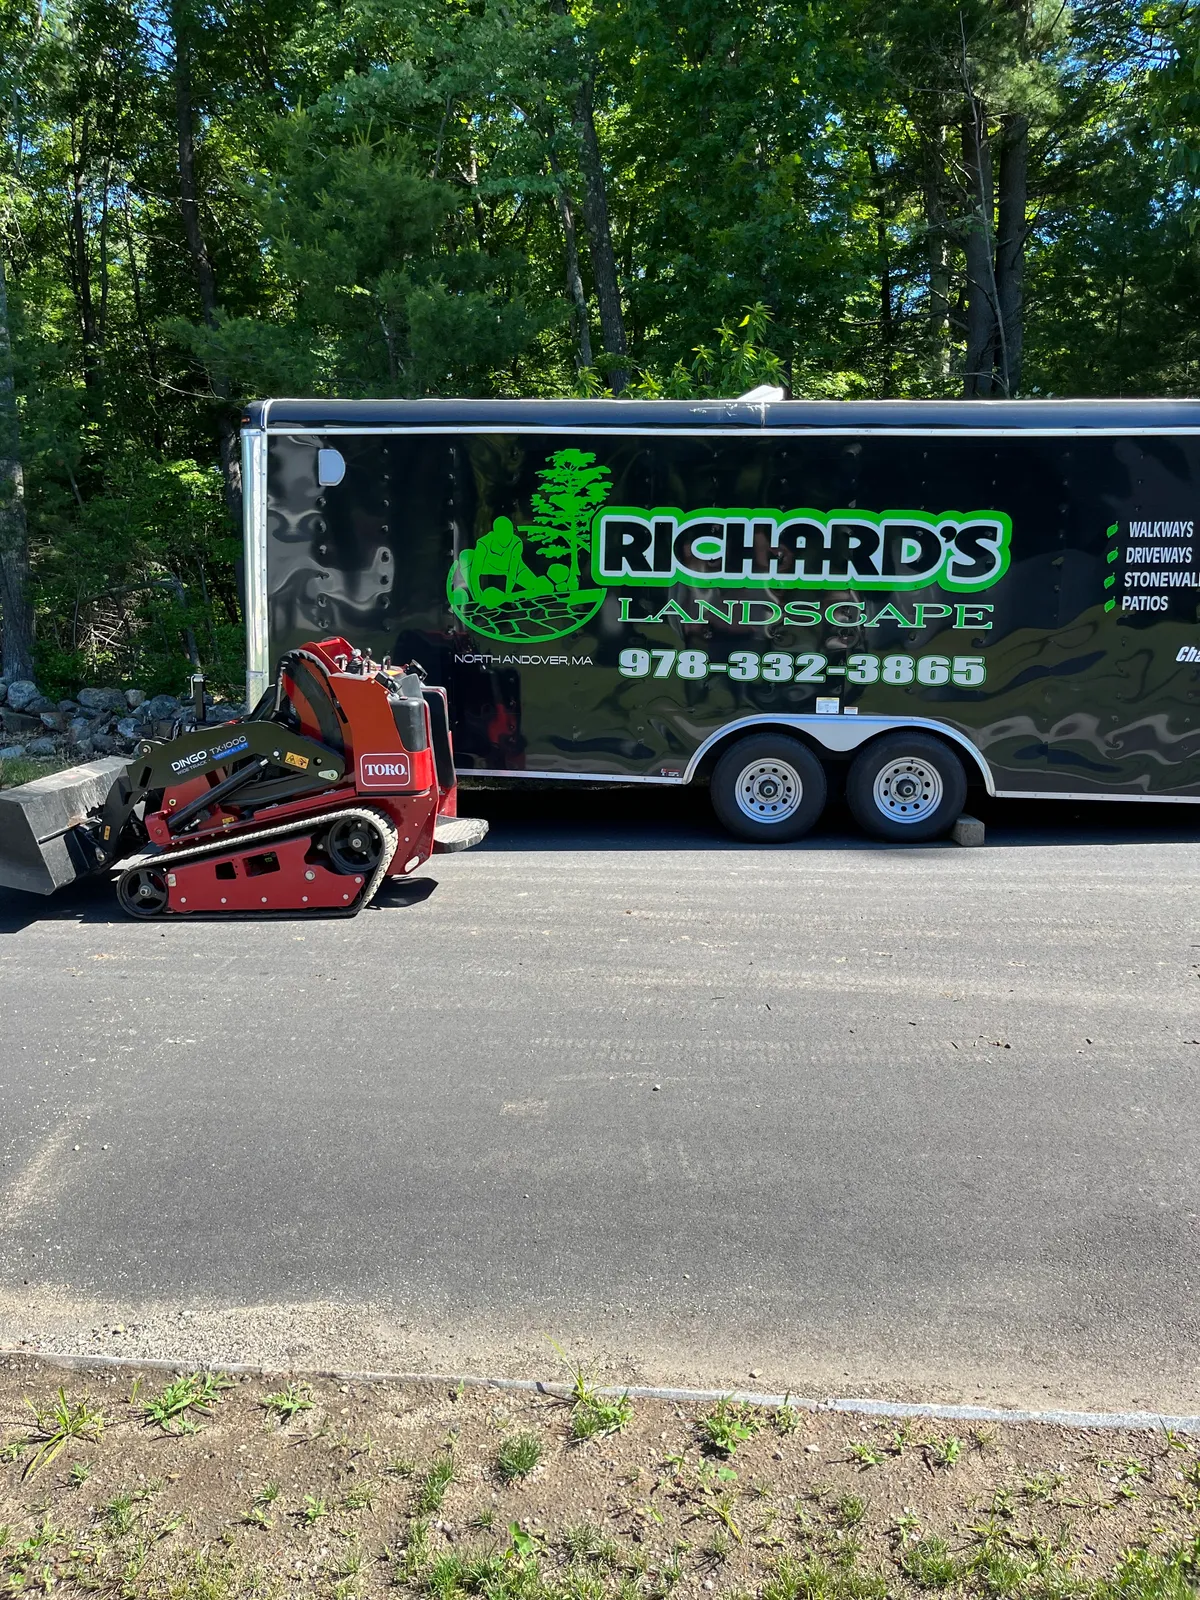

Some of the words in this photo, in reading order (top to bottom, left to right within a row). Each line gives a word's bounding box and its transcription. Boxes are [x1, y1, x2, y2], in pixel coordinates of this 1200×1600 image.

[1129, 521, 1194, 538] WALKWAYS
[603, 521, 998, 577] RICHARD'S
[1125, 546, 1193, 564] DRIVEWAYS
[1124, 571, 1200, 587] STONEWAL
[1121, 595, 1169, 611] PATIOS
[617, 597, 994, 629] LANDSCAPE
[454, 654, 500, 664] NORTH
[502, 655, 570, 666] ANDOVER,
[571, 656, 593, 665] MA
[617, 648, 987, 686] 978-332-3865
[171, 750, 208, 771] DINGO
